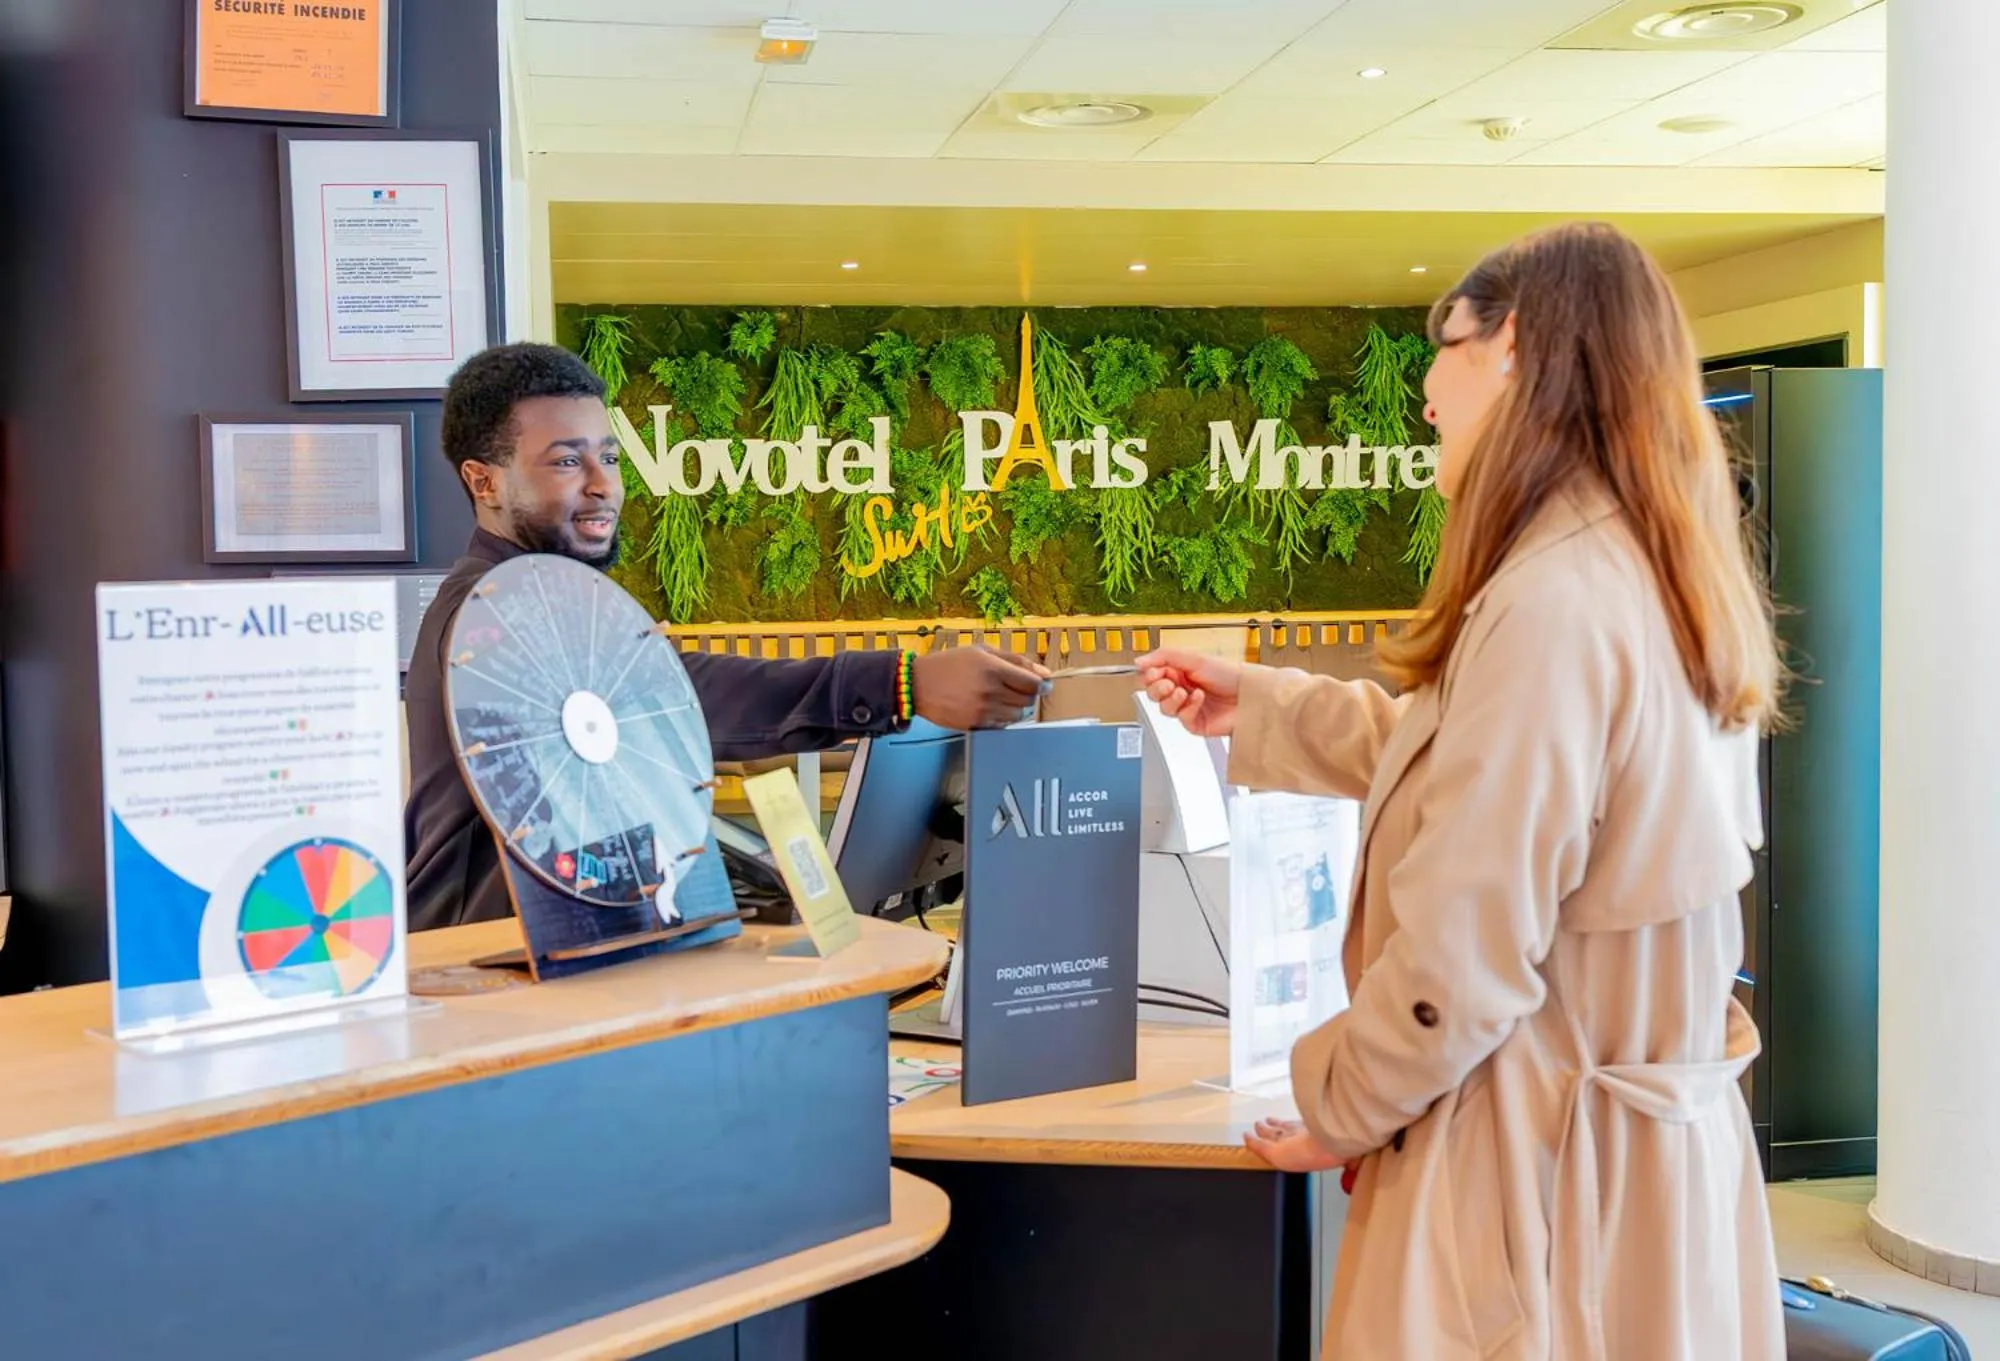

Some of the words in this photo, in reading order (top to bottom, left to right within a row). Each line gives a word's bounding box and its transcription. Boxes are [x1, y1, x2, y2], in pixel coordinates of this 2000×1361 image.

[293, 4, 366, 20] INCENDIE
[609, 404, 896, 497] Novotel
[1205, 418, 1440, 490] Montre
[1068, 790, 1108, 803] ACCOR
[987, 778, 1062, 840] All
[1068, 807, 1093, 819] LIVE
[1067, 821, 1125, 835] LIMITLESS
[996, 963, 1049, 981] PRIORITY
[1051, 956, 1109, 975] WELCOME
